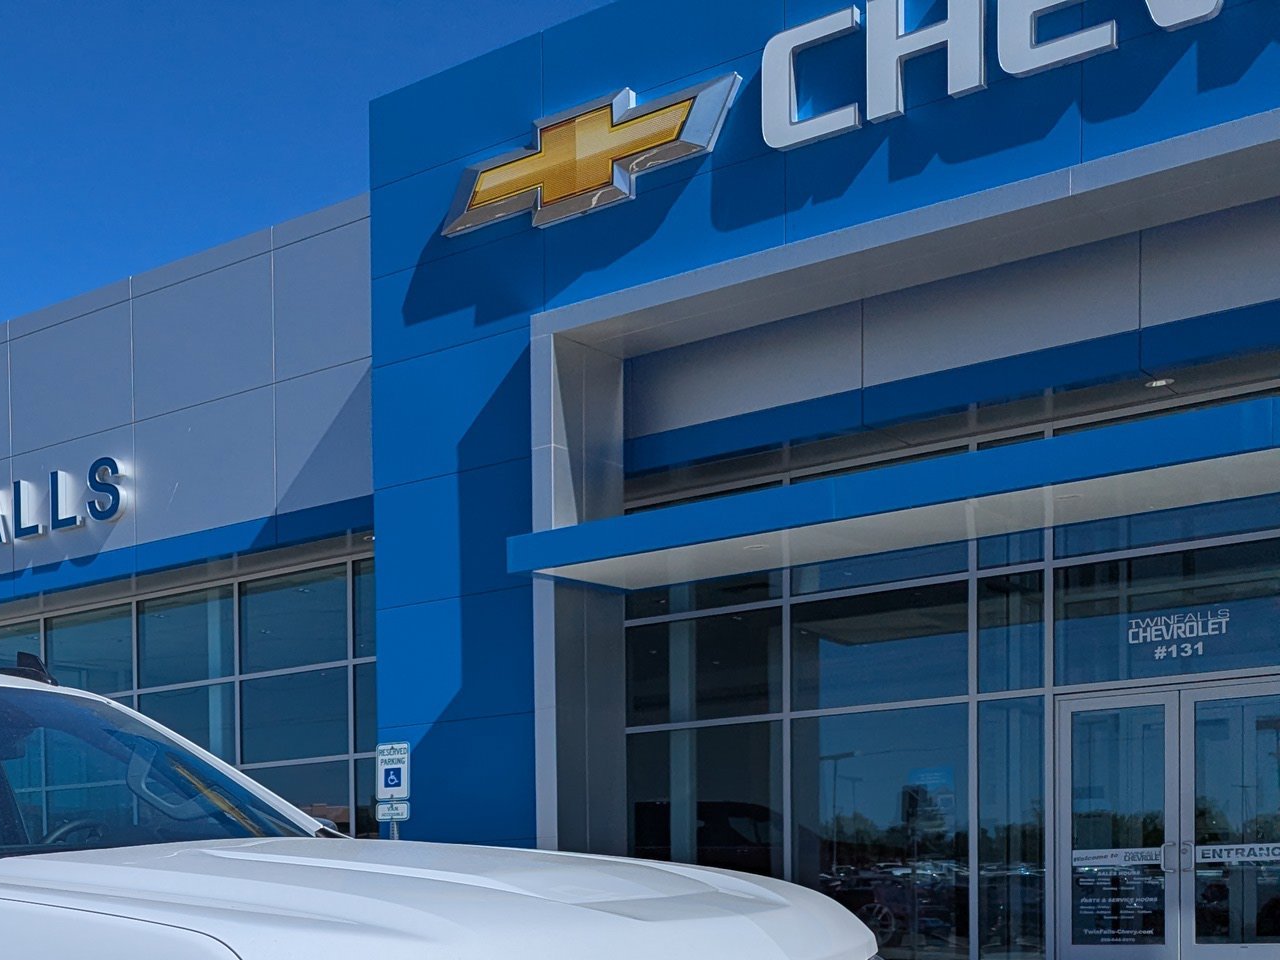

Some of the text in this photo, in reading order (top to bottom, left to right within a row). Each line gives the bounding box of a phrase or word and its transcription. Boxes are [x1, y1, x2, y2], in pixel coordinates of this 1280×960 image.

[761, 0, 1223, 152] CHE
[1128, 617, 1230, 644] CHEVROLET
[1154, 641, 1204, 660] #131
[379, 747, 408, 757] RESERVED
[380, 758, 406, 766] PARKING
[1123, 852, 1160, 862] CHEVROLE
